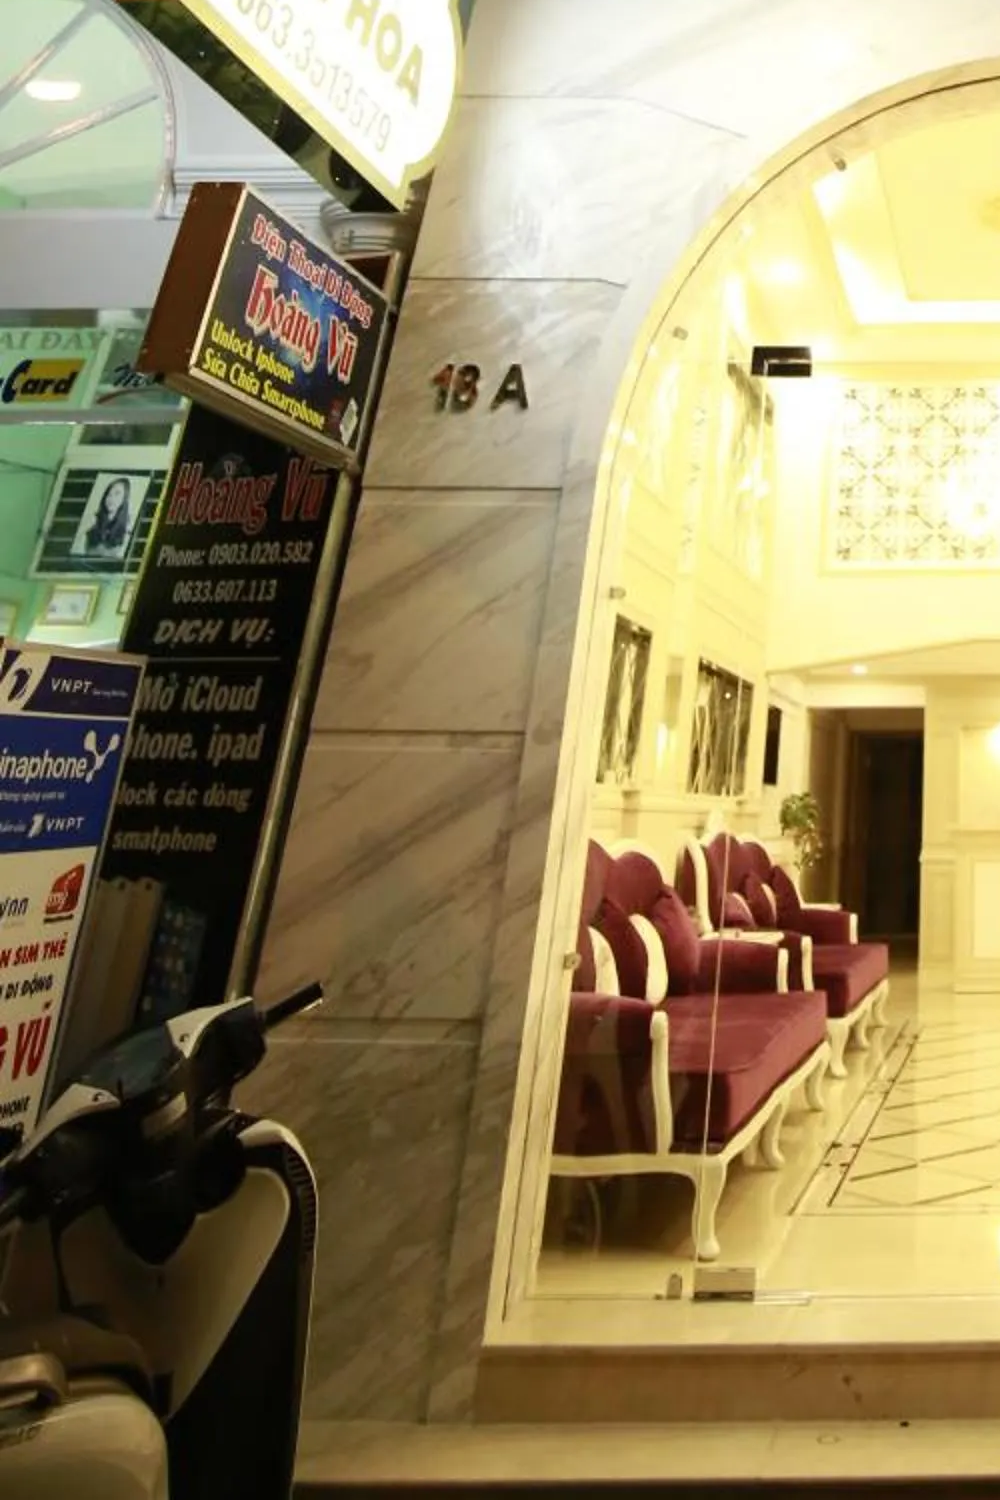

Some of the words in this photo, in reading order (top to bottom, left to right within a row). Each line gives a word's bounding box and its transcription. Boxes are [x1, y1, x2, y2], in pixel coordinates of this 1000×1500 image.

[212, 319, 254, 362] Unlock
[490, 363, 529, 412] A
[261, 380, 325, 430] Smartphone
[157, 544, 206, 567] Phone:
[153, 619, 224, 649] DỊCH
[51, 677, 93, 694] VNPT
[181, 674, 263, 711] iCloud
[207, 723, 266, 766] ipad
[0, 747, 88, 784] inaphone
[164, 781, 199, 807] các
[46, 816, 85, 834] VNPT
[13, 942, 39, 966] SIM
